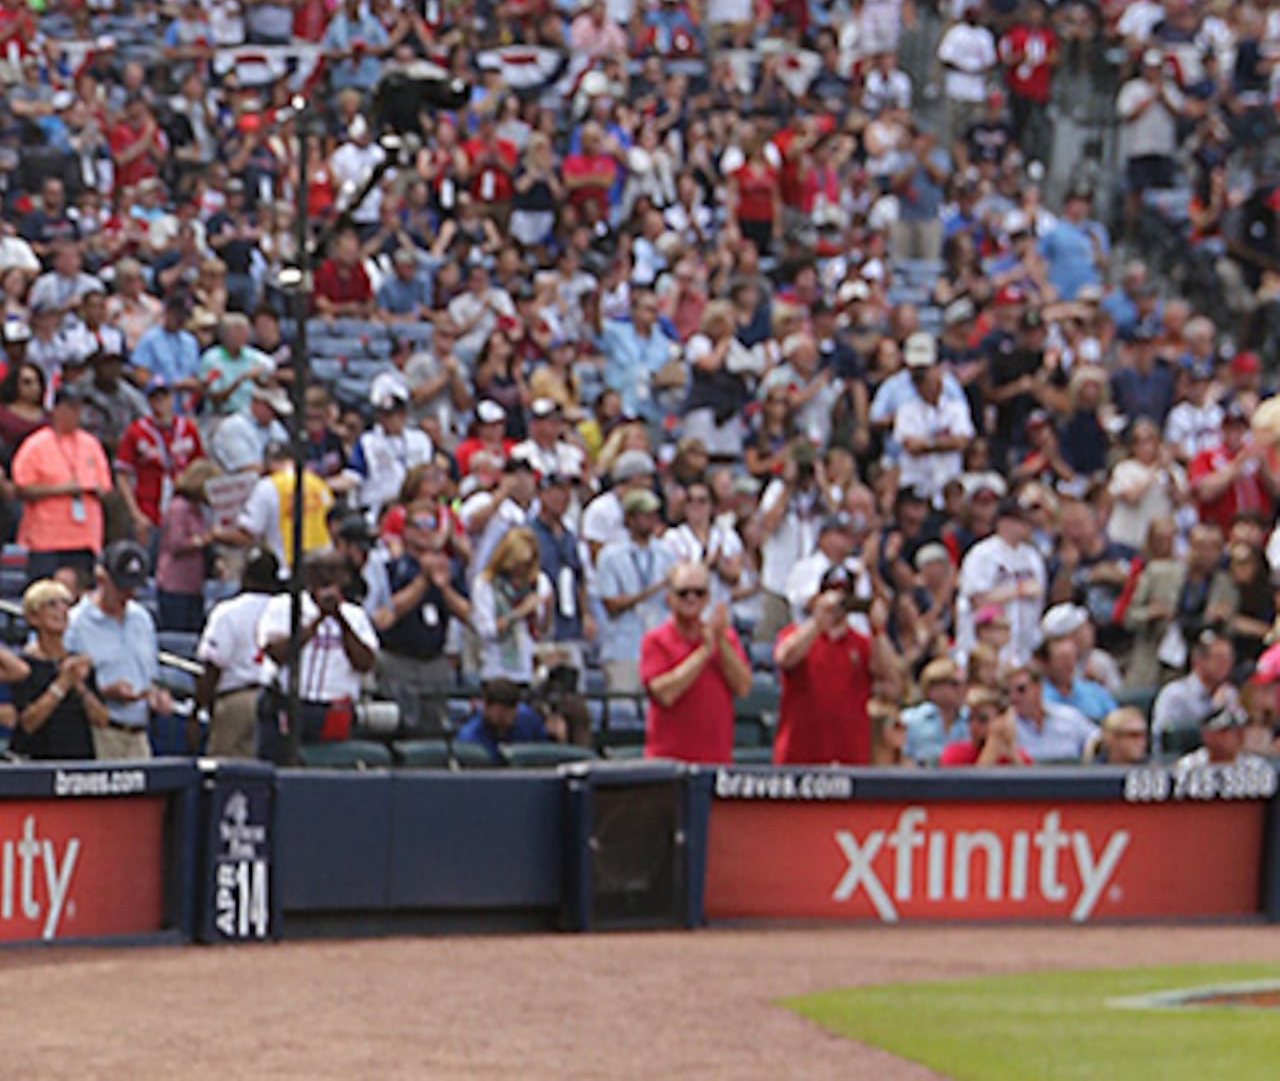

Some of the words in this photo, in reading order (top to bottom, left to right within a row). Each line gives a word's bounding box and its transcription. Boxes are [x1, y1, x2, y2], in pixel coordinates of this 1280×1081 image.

[55, 769, 145, 796] braves.com
[715, 768, 853, 799] braves.com
[832, 806, 1130, 922] xfinity
